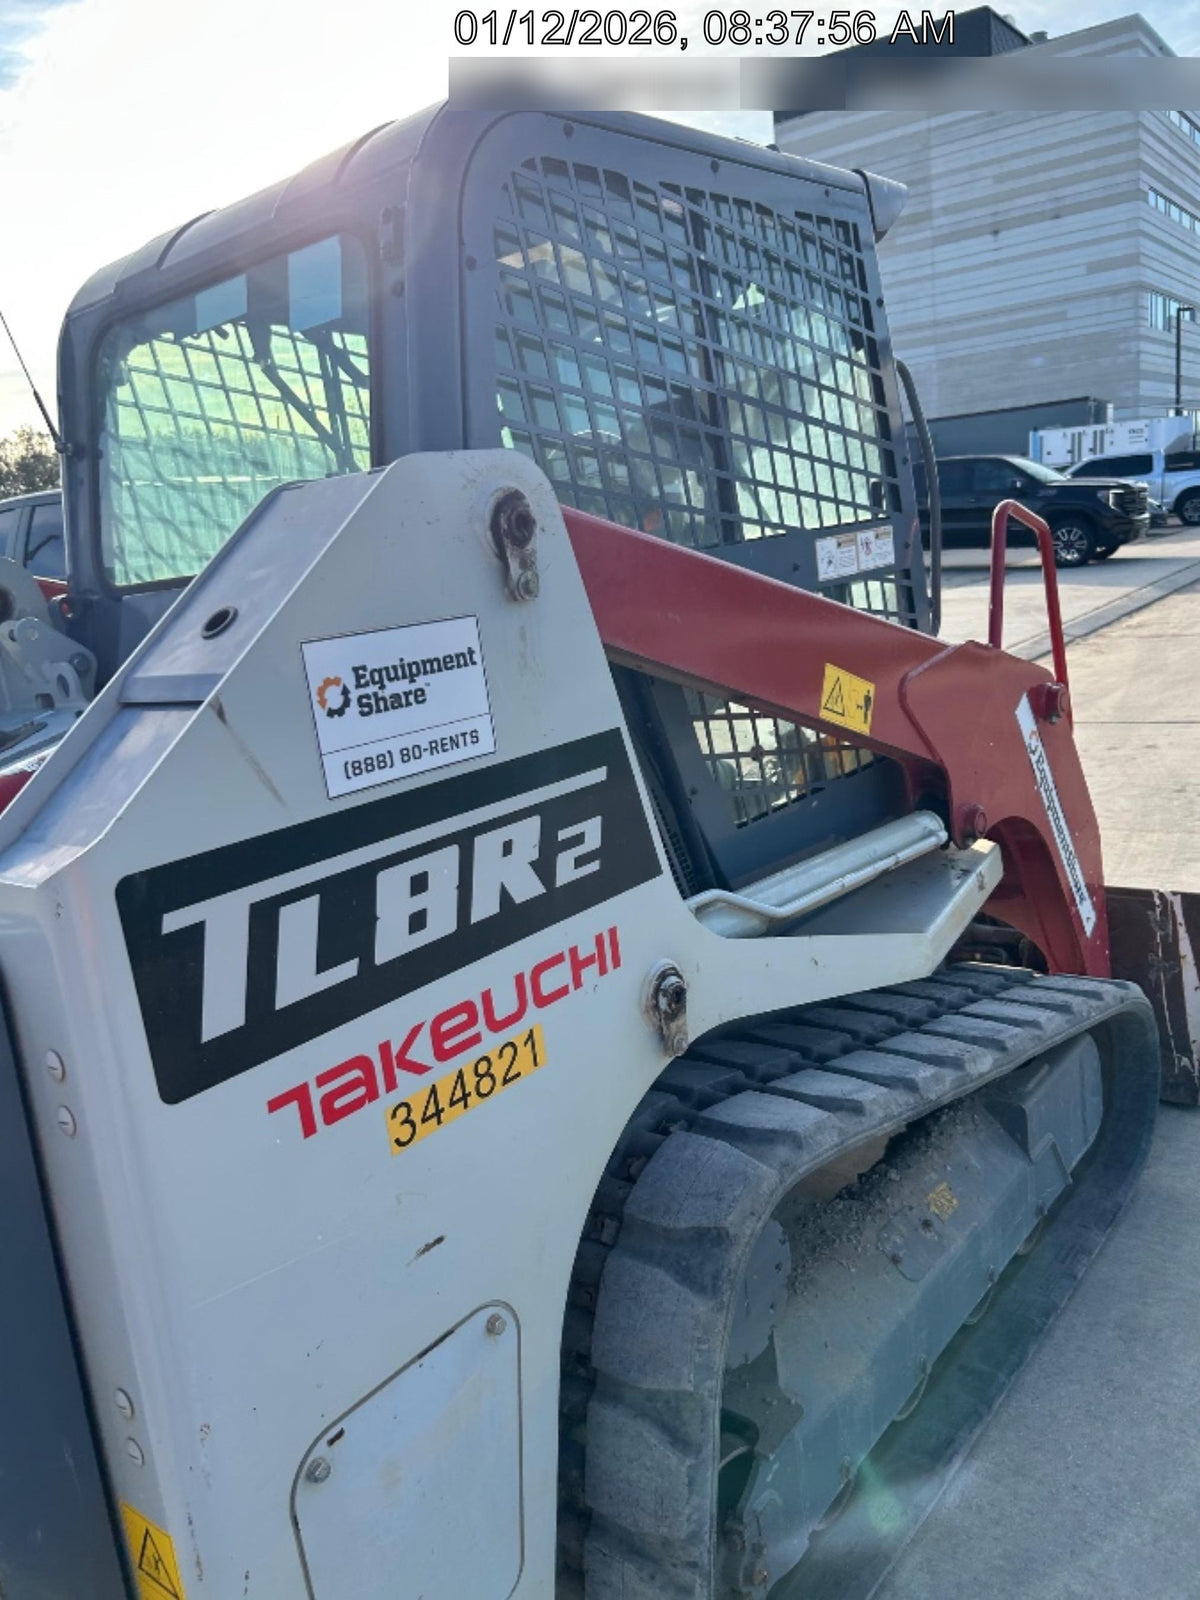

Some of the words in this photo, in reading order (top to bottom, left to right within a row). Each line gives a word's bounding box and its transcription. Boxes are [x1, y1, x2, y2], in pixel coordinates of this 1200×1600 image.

[351, 646, 478, 690] Equipment
[356, 686, 428, 718] Share
[343, 749, 395, 780] (888)
[399, 728, 480, 764] 80-RENTS
[160, 764, 609, 1045] TL8R2
[389, 1027, 541, 1149] 344821
